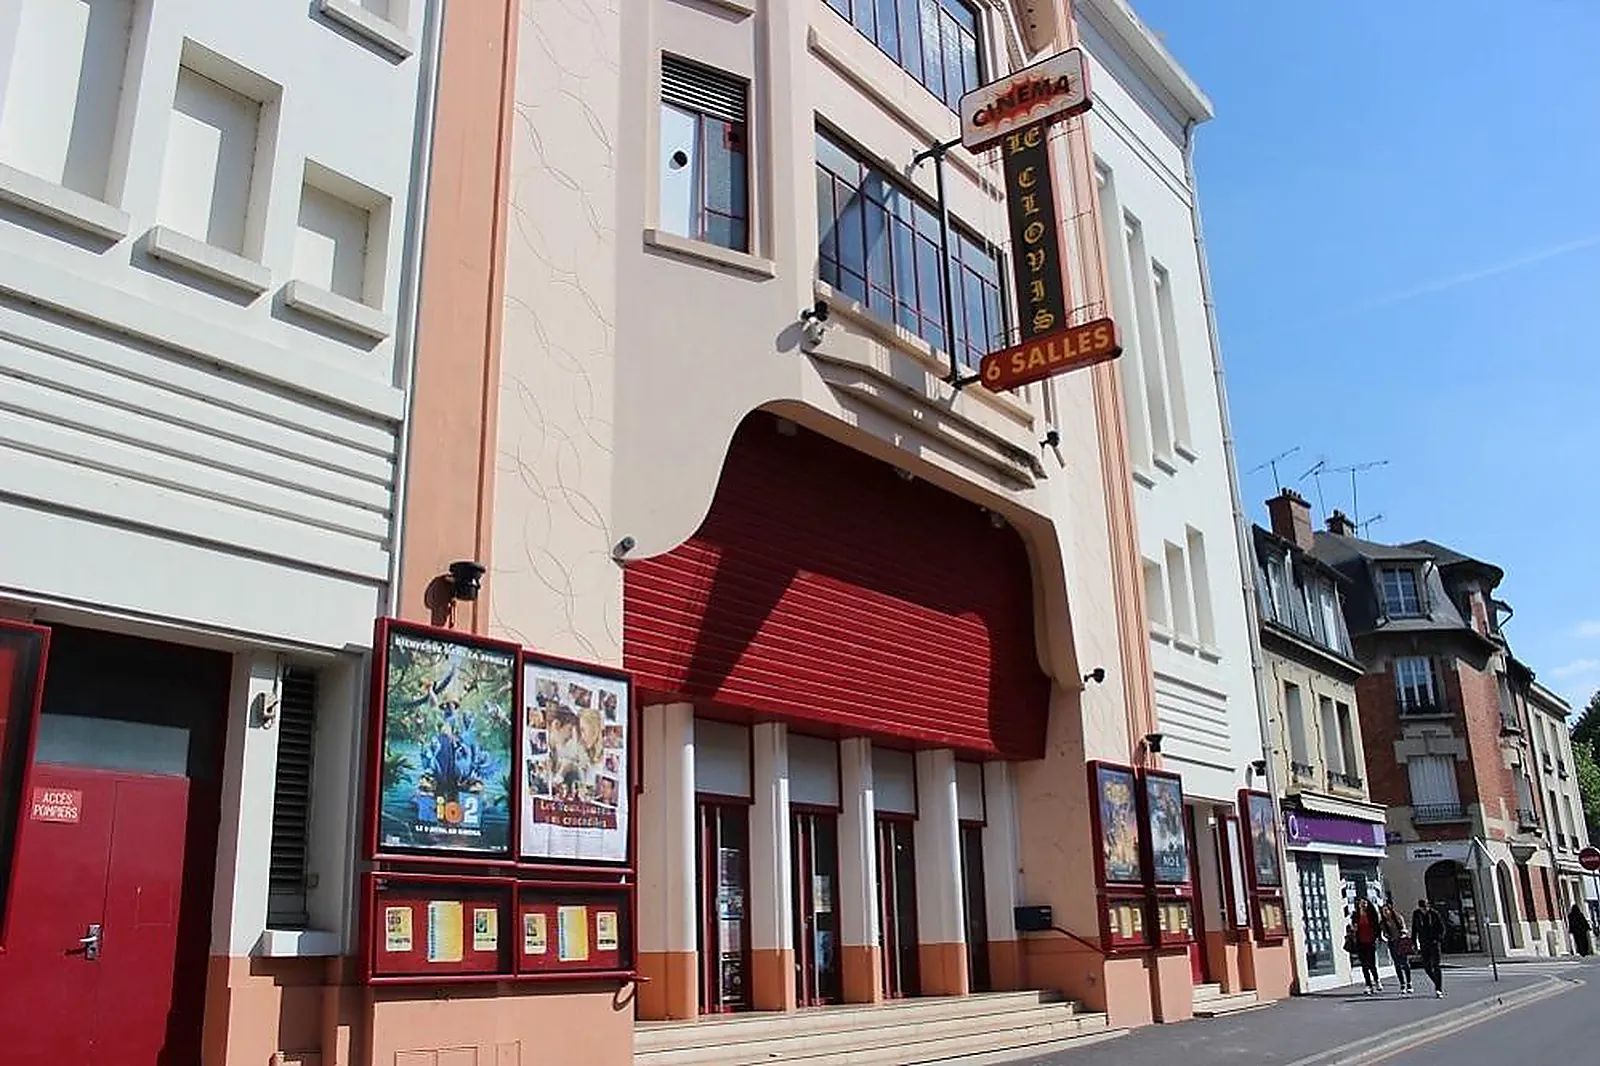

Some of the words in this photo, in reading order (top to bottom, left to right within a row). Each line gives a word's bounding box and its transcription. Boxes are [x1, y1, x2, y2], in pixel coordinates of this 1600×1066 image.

[971, 74, 1071, 127] CINEMA
[1006, 127, 1043, 153] LE
[1017, 166, 1055, 333] CLOVIS
[986, 360, 1000, 382] 6
[1011, 326, 1111, 374] SALLES
[33, 803, 78, 819] POMPIERS
[464, 796, 480, 824] 2
